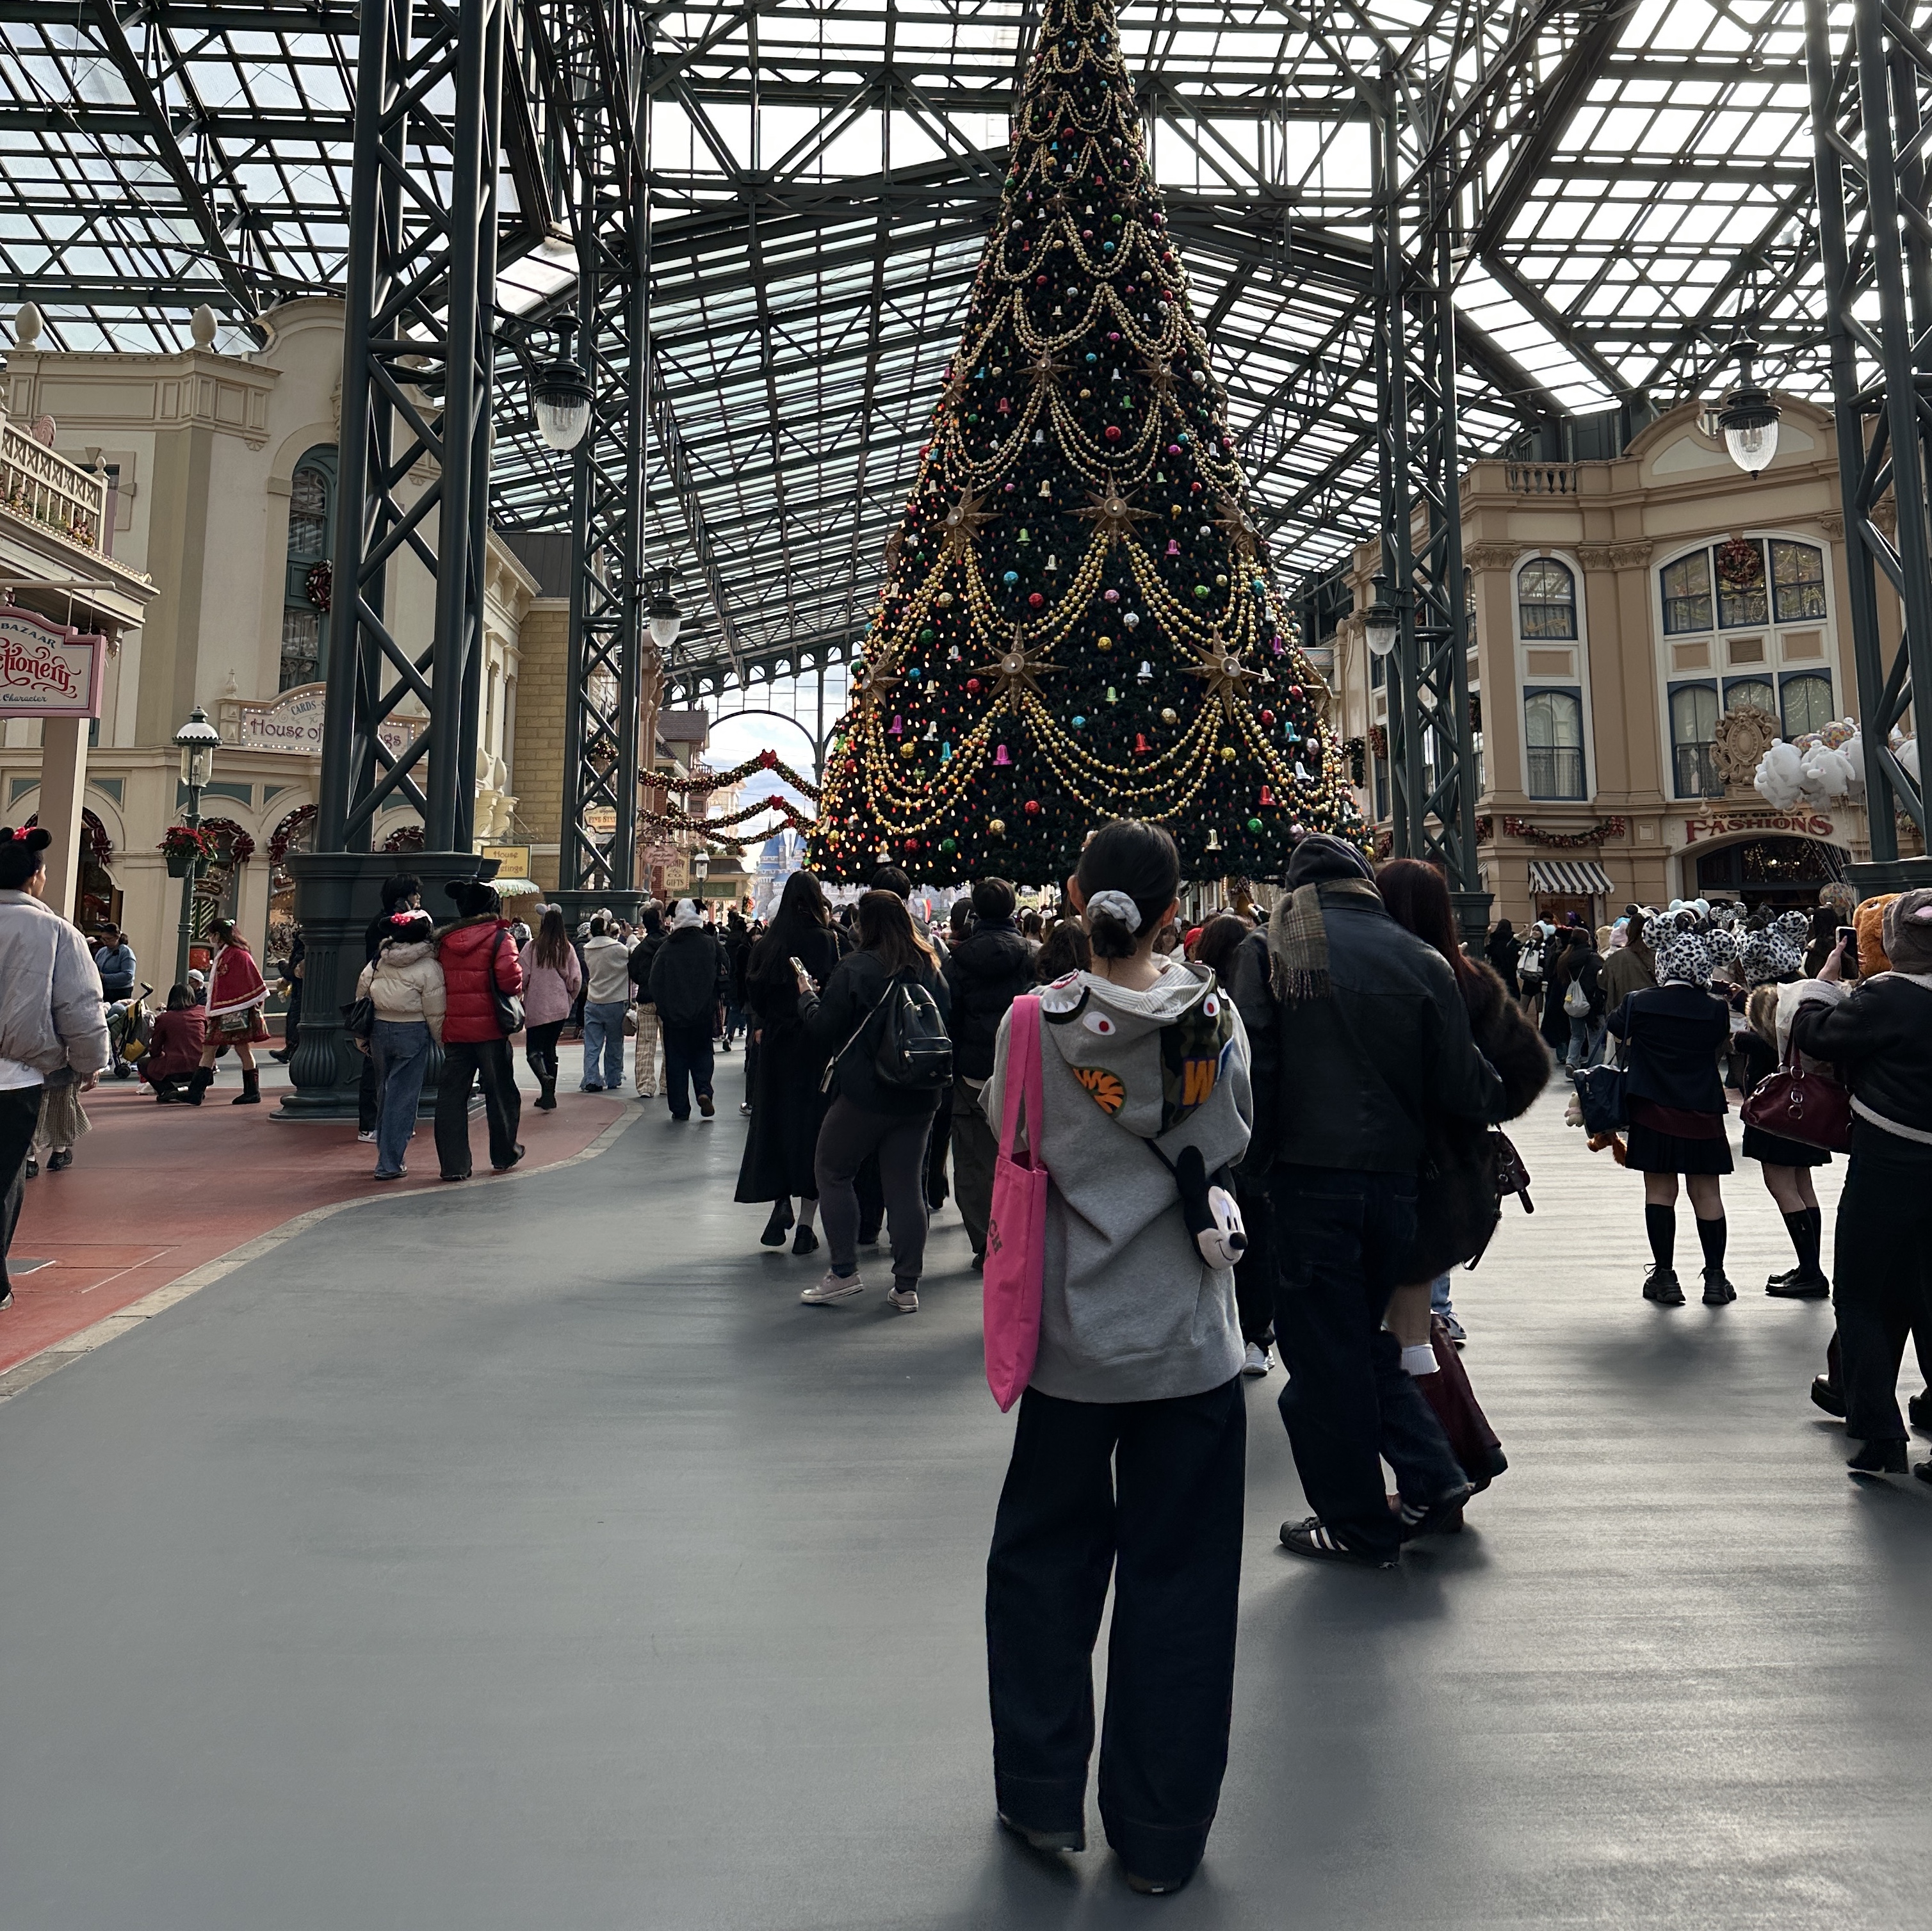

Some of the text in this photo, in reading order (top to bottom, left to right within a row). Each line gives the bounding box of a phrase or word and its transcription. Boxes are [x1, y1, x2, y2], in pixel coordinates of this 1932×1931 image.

[1, 622, 56, 649] BAZAAR
[3, 693, 47, 702] Character
[291, 700, 316, 715] CARDS
[250, 718, 304, 739] House
[307, 723, 324, 743] of
[1685, 815, 1833, 844] FASHIONS
